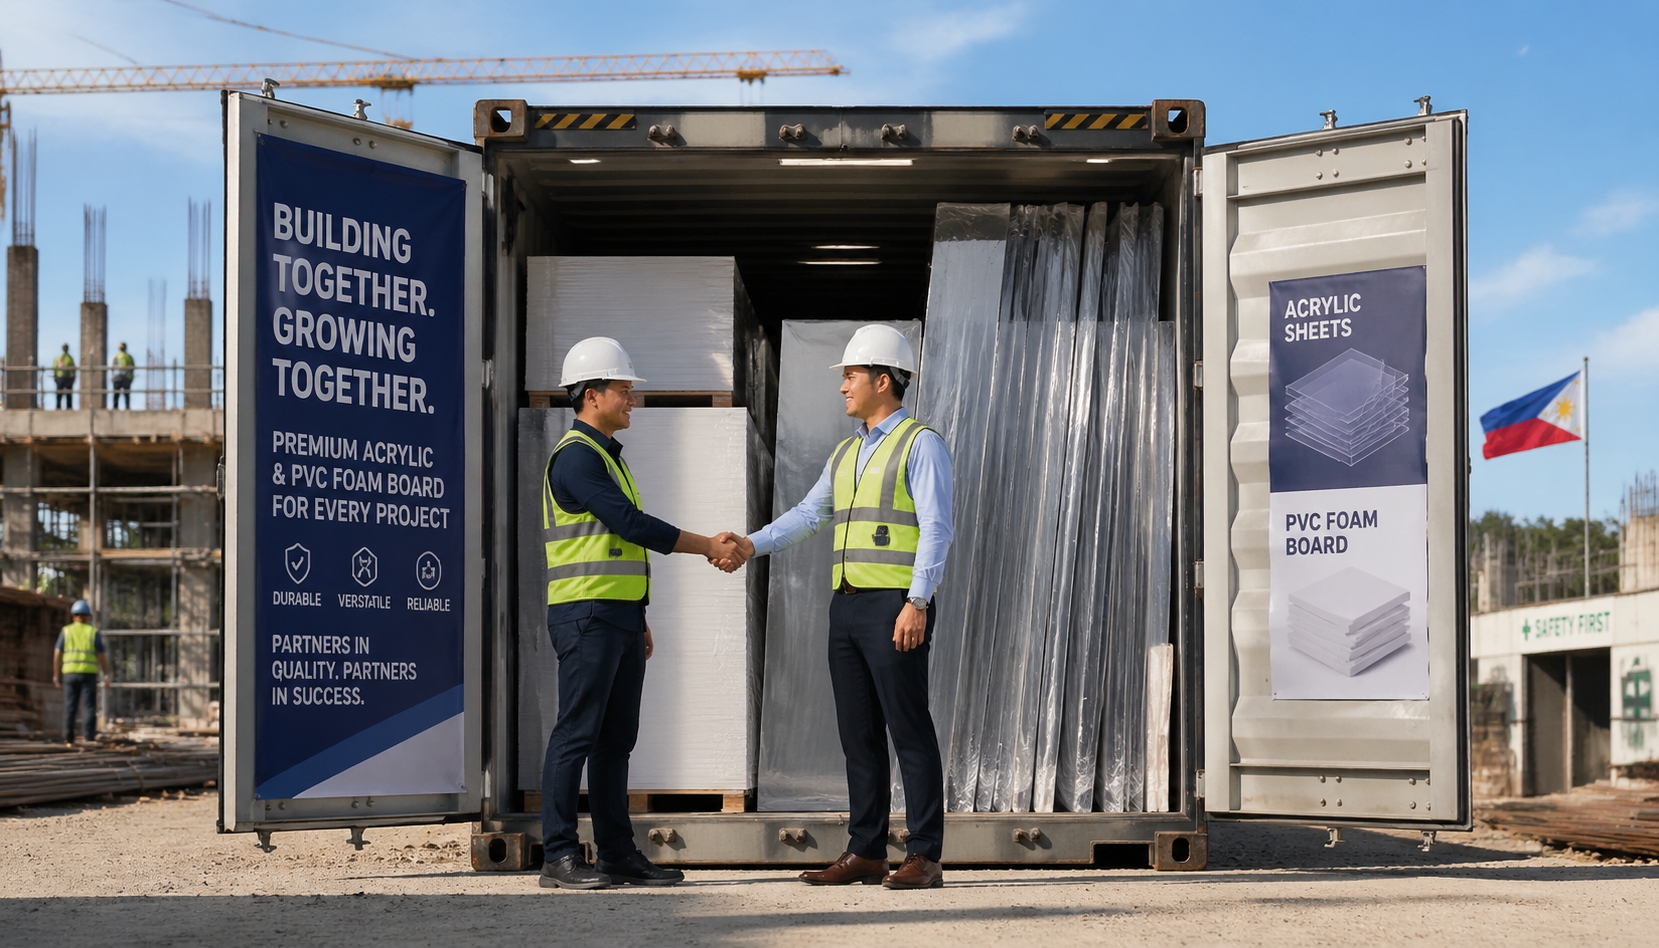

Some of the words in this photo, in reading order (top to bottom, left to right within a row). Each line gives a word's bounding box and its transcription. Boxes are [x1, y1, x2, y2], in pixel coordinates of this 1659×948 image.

[274, 202, 412, 264] BUILDING
[272, 253, 436, 317] TOGETHER.
[1284, 293, 1362, 319] ACRYLIC
[272, 306, 416, 363] GROWING
[1284, 318, 1352, 343] SHEETS
[272, 358, 435, 414] TOGETHER.
[273, 431, 357, 461] PREMIUM
[362, 440, 434, 468] ACRYLIC
[272, 463, 286, 486] &
[291, 464, 328, 489] PVC
[333, 467, 383, 494] FOAM
[387, 473, 445, 499] BOARD
[272, 495, 309, 519] FOR
[314, 497, 372, 523] EVERY
[376, 502, 450, 529] PROJECT
[1285, 513, 1321, 532] PVC
[1326, 510, 1378, 530] FOAM
[1285, 535, 1349, 556] BOARD
[273, 591, 321, 607] DURABLE
[407, 597, 450, 612] RELIABLE
[1535, 616, 1575, 638] SAFETY
[1578, 612, 1610, 634] FIRST
[272, 634, 351, 654] PARTNERS
[354, 636, 370, 655] IN
[343, 661, 418, 681] PARTNERS
[272, 686, 288, 706] IN
[292, 686, 365, 706] SUCCESS.
